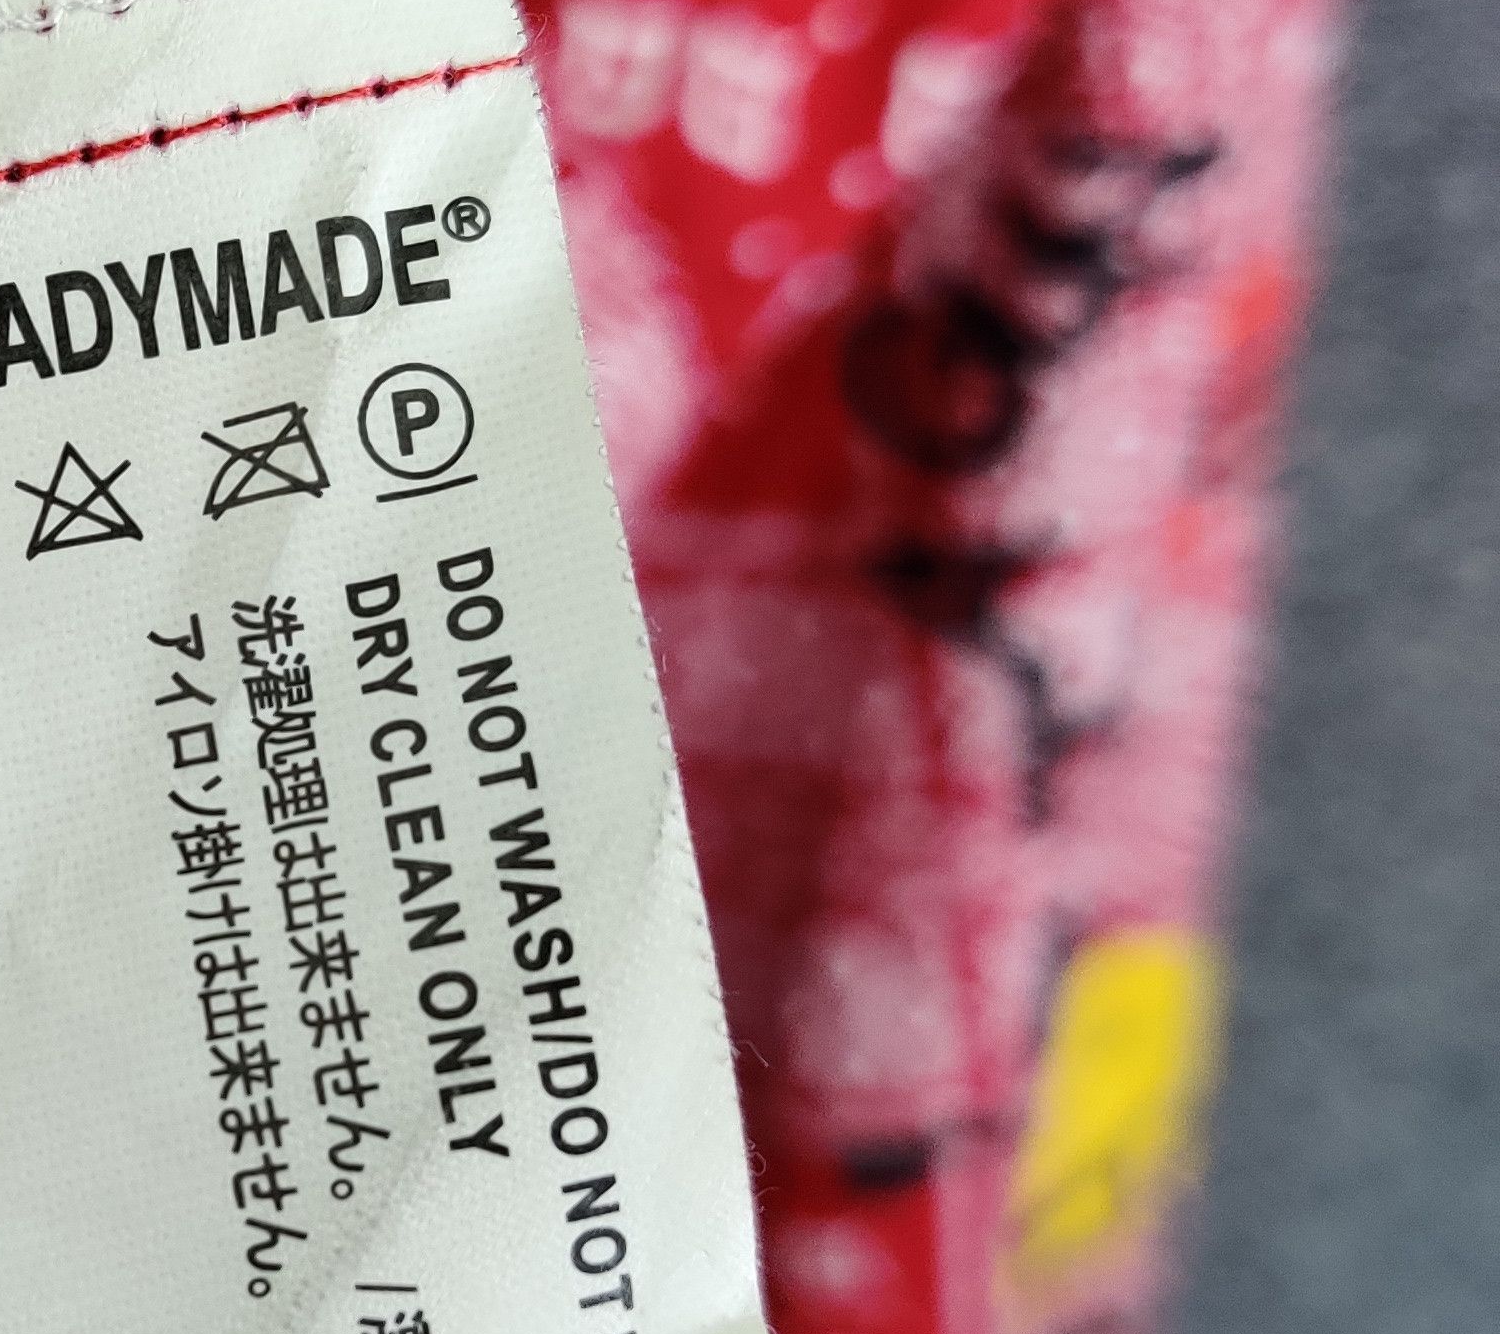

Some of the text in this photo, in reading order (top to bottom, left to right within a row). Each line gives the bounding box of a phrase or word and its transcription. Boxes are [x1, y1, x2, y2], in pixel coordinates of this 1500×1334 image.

[436, 546, 505, 642] DO
[456, 654, 539, 790] NOT
[146, 612, 309, 1299] アイロン掛けは出来ません。
[230, 594, 391, 1201] 洗濯処理は出来ません。
[344, 572, 511, 1158] DRY CLEAN ONLY
[488, 807, 610, 1157] WASH/DO
[561, 1173, 635, 1312] NOT
